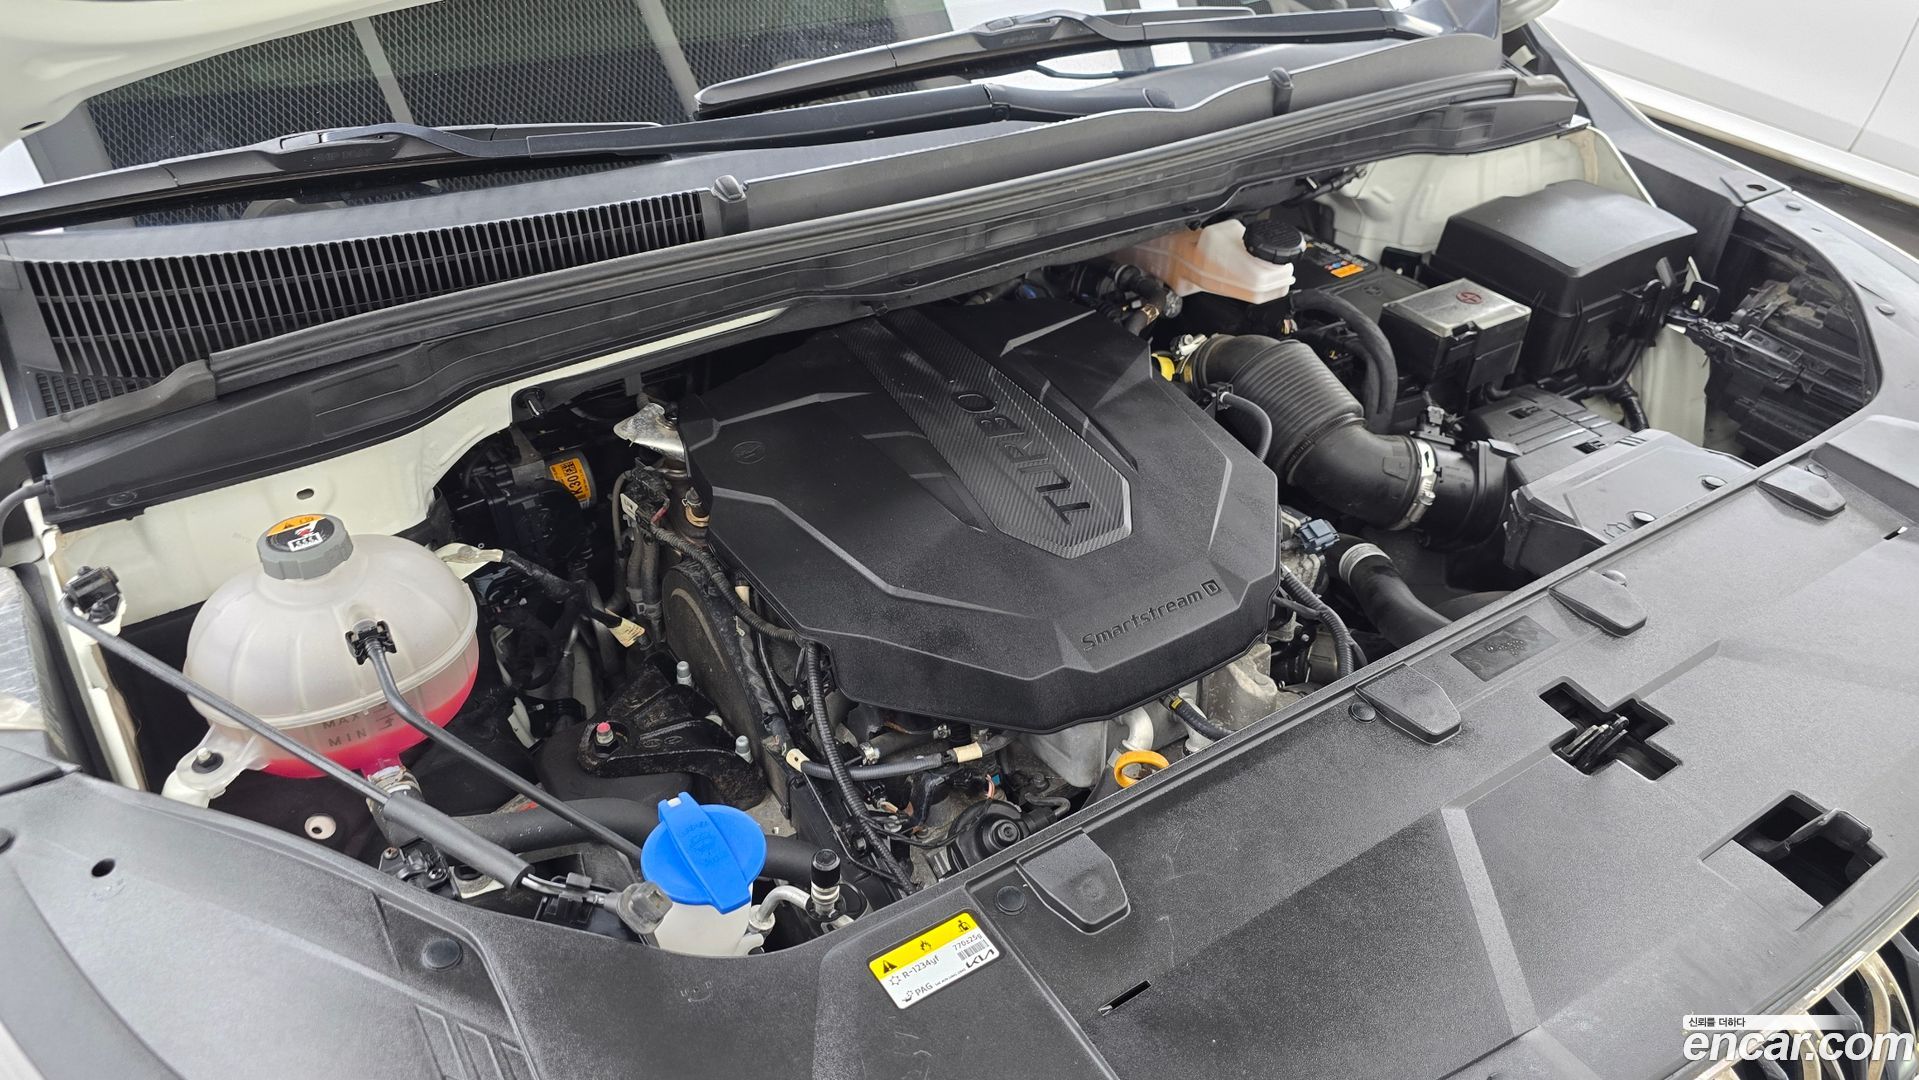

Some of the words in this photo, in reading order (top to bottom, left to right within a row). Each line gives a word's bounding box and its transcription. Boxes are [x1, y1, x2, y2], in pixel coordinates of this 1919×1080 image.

[955, 391, 1091, 526] TURBO
[1082, 589, 1204, 650] Smartstream
[328, 728, 367, 747] MIN
[902, 955, 940, 979] R-1234yf
[915, 983, 934, 996] PAG
[966, 949, 995, 969] KIA
